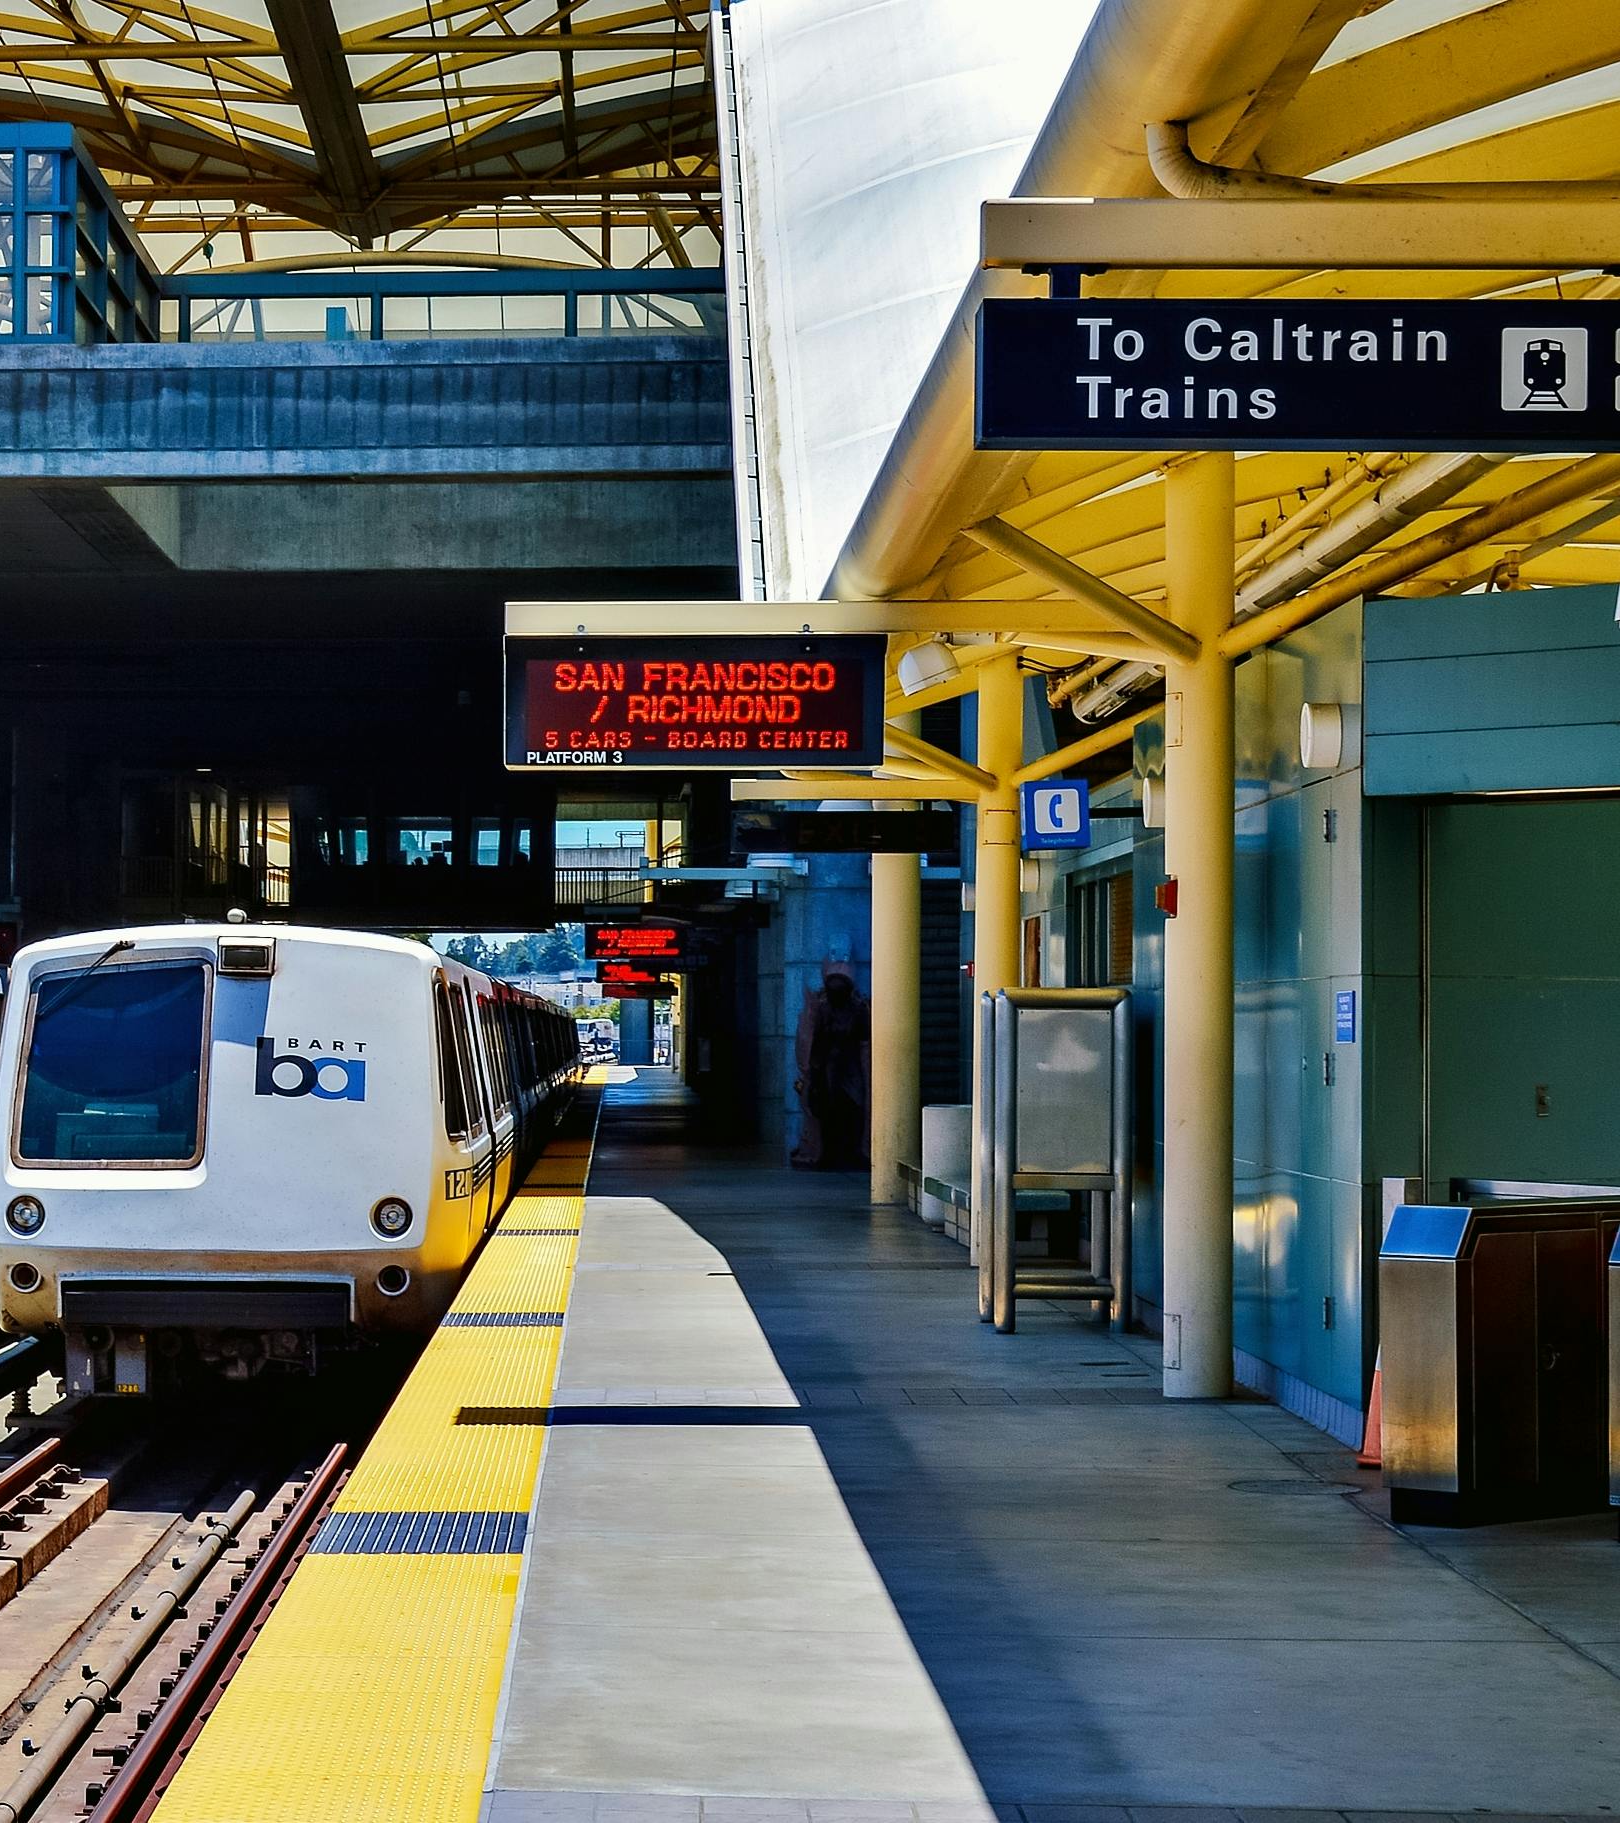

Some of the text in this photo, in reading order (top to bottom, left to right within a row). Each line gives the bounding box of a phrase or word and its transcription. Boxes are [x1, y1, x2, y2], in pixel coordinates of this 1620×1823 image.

[1076, 316, 1449, 362] To Caltrain
[1076, 375, 1277, 420] Trains
[554, 662, 836, 692] SAN FRANCISCO
[589, 694, 802, 724] / RICHMOND
[544, 730, 559, 749] 5
[569, 730, 633, 749] CARS
[667, 730, 748, 749] BOARD
[758, 730, 849, 749] CENTER
[526, 751, 623, 765] PLATFORM 3
[287, 1037, 367, 1053] BART
